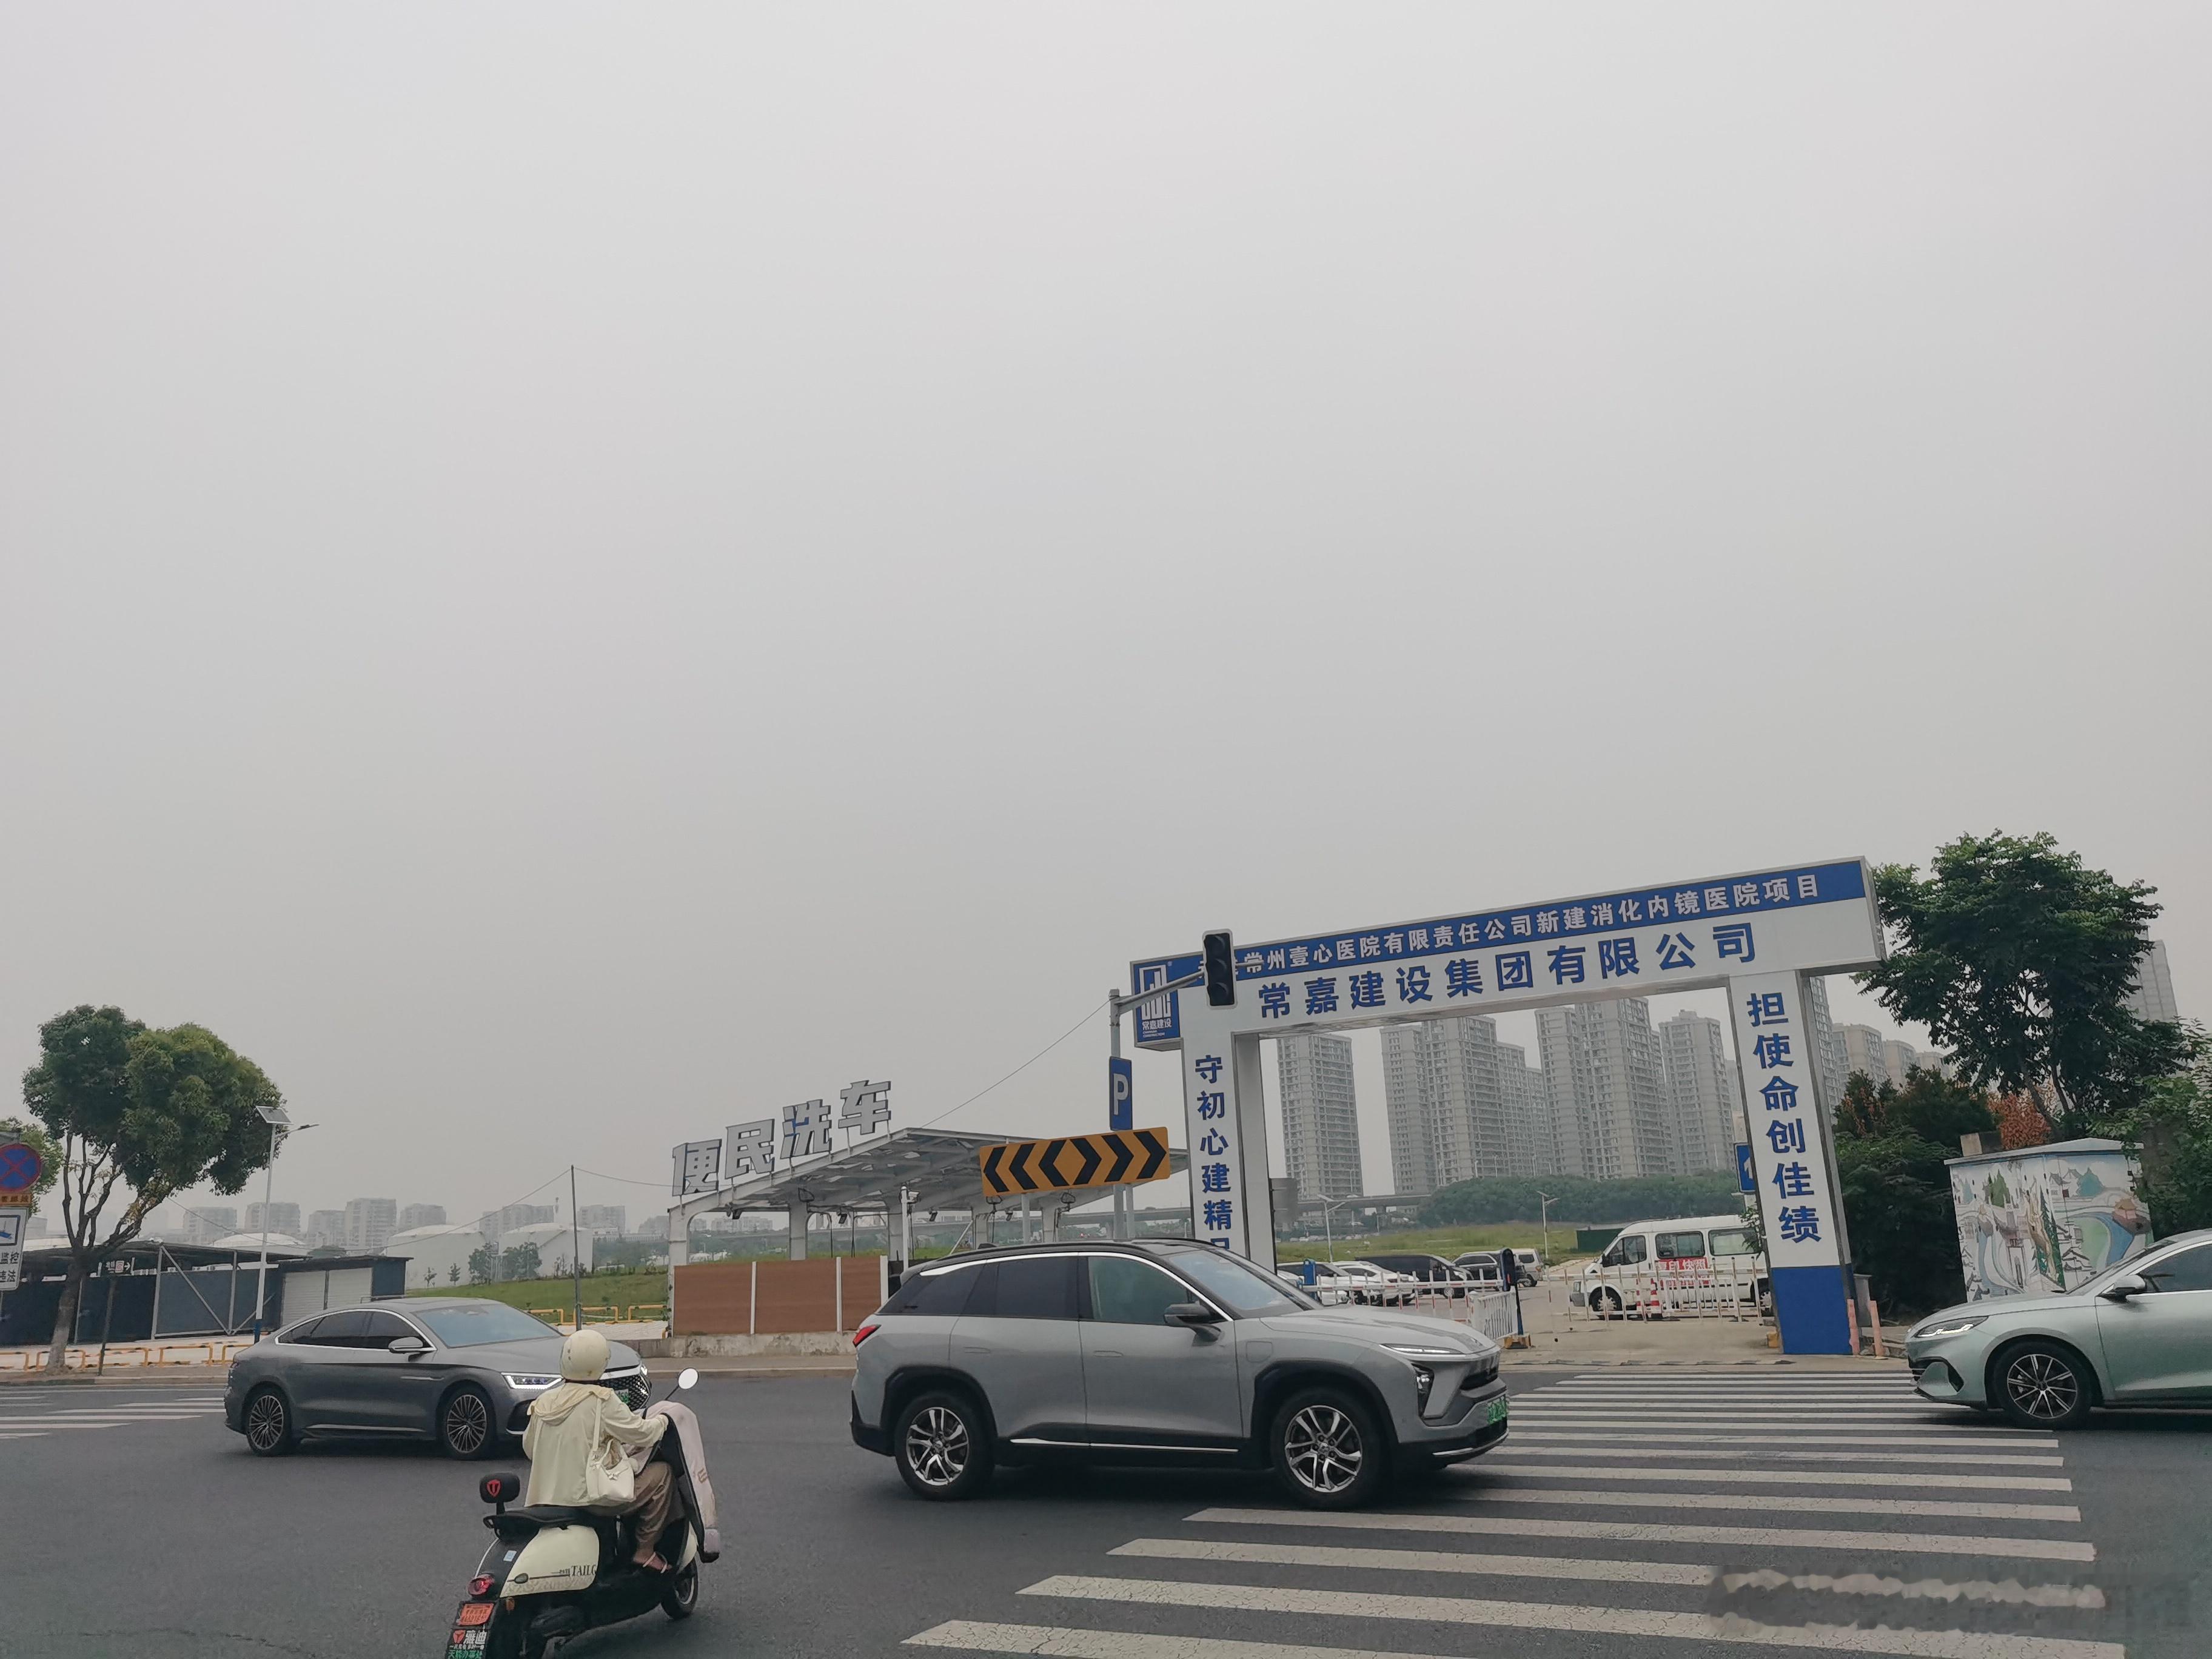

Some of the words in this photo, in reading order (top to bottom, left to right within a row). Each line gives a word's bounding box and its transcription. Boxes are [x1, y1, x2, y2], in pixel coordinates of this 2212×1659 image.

[1198, 874, 1818, 979] 常州壹心医院有限责任公司新建消化内镜医院项目
[1258, 922, 1755, 1019] 常嘉建设集团有限公司
[672, 1079, 891, 1197] 便民洗车
[1113, 1073, 1129, 1116] P
[1746, 992, 1822, 1244] 担使命创佳绩
